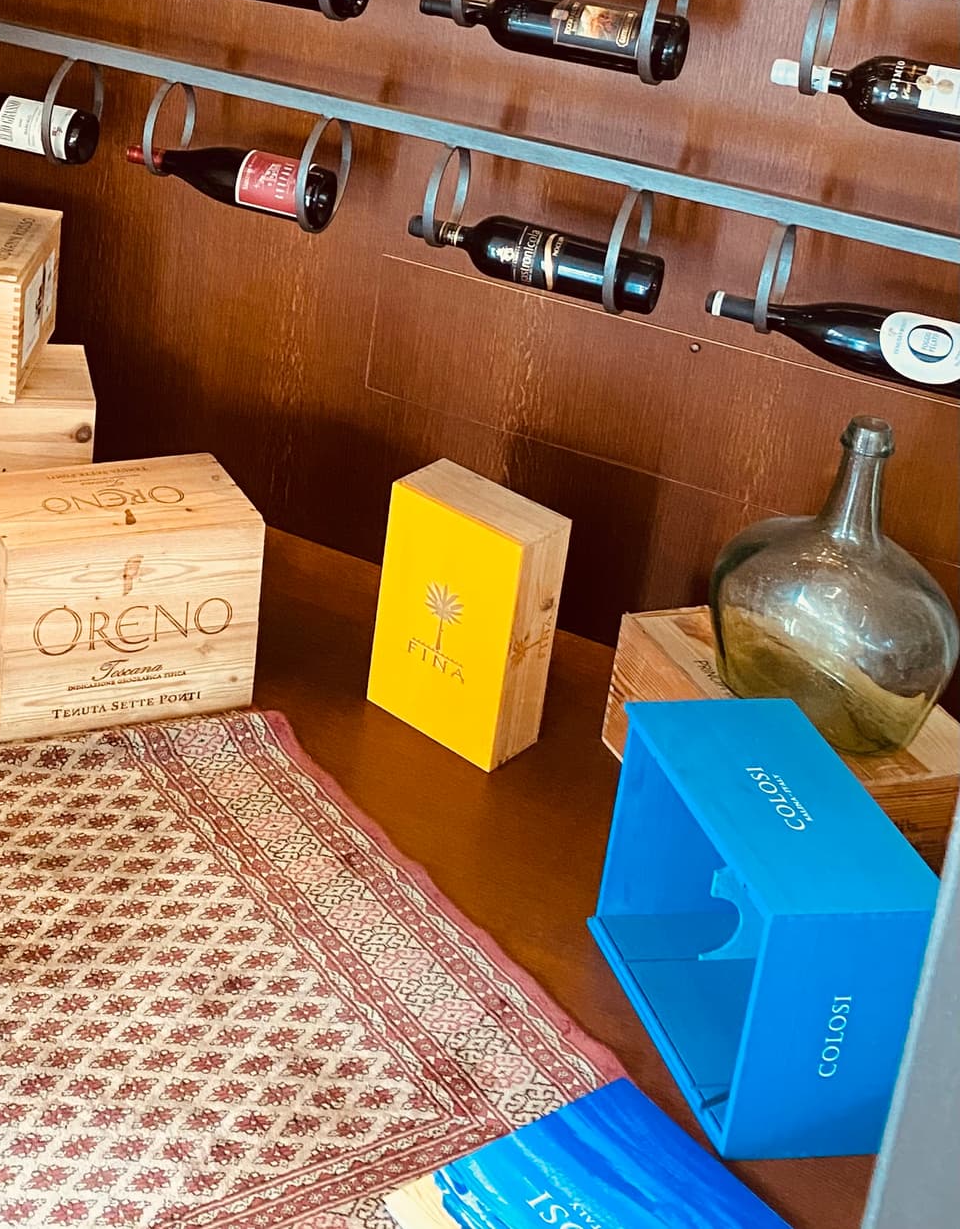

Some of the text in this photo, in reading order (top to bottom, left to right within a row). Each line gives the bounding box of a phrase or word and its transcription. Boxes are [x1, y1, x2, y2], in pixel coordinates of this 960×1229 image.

[889, 60, 905, 100] OPIMIO
[41, 485, 185, 514] ORENO
[33, 597, 233, 657] ORENO
[91, 659, 164, 682] Toscana
[407, 640, 465, 685] FINA
[52, 691, 201, 720] TENUTA SETTE PONTI
[745, 766, 806, 831] COLOSI
[818, 995, 852, 1078] COLOSI
